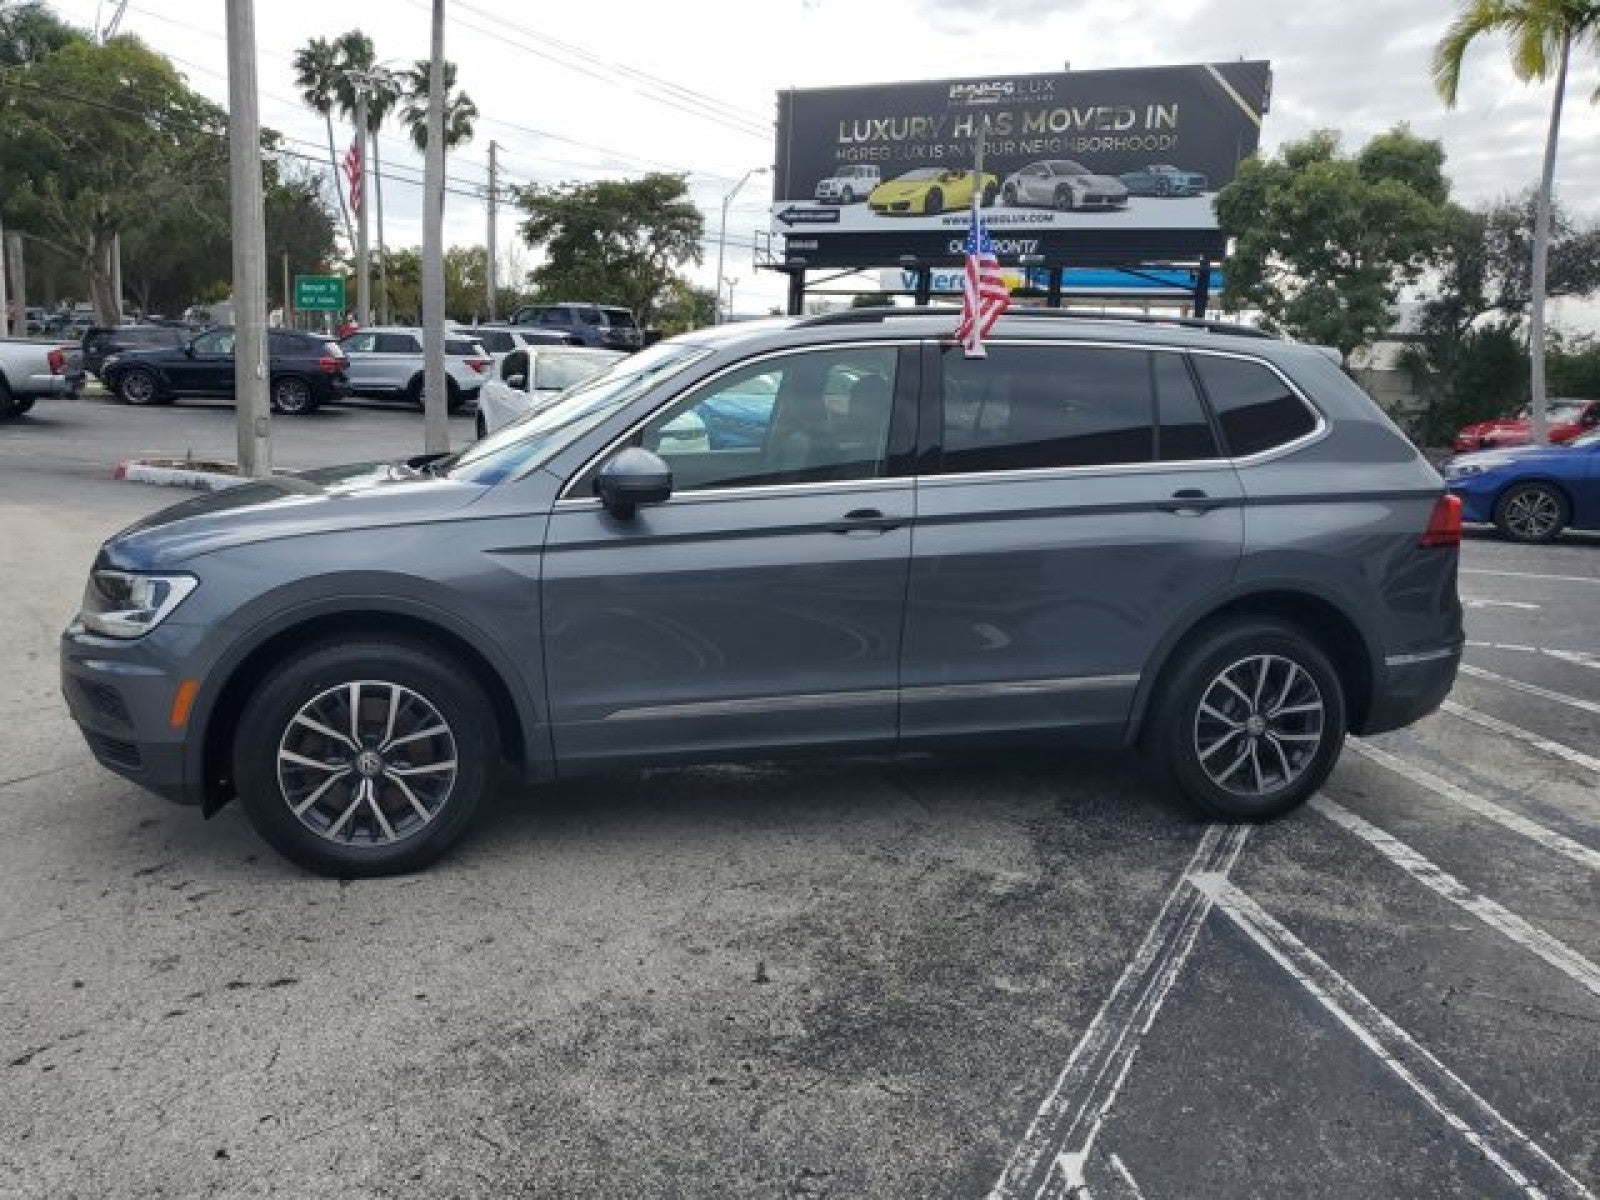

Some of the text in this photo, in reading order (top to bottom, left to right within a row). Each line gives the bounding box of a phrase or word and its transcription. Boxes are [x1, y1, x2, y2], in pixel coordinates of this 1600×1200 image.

[839, 102, 1179, 143] LUXURY HAS MOVED IN
[929, 143, 944, 159] IS
